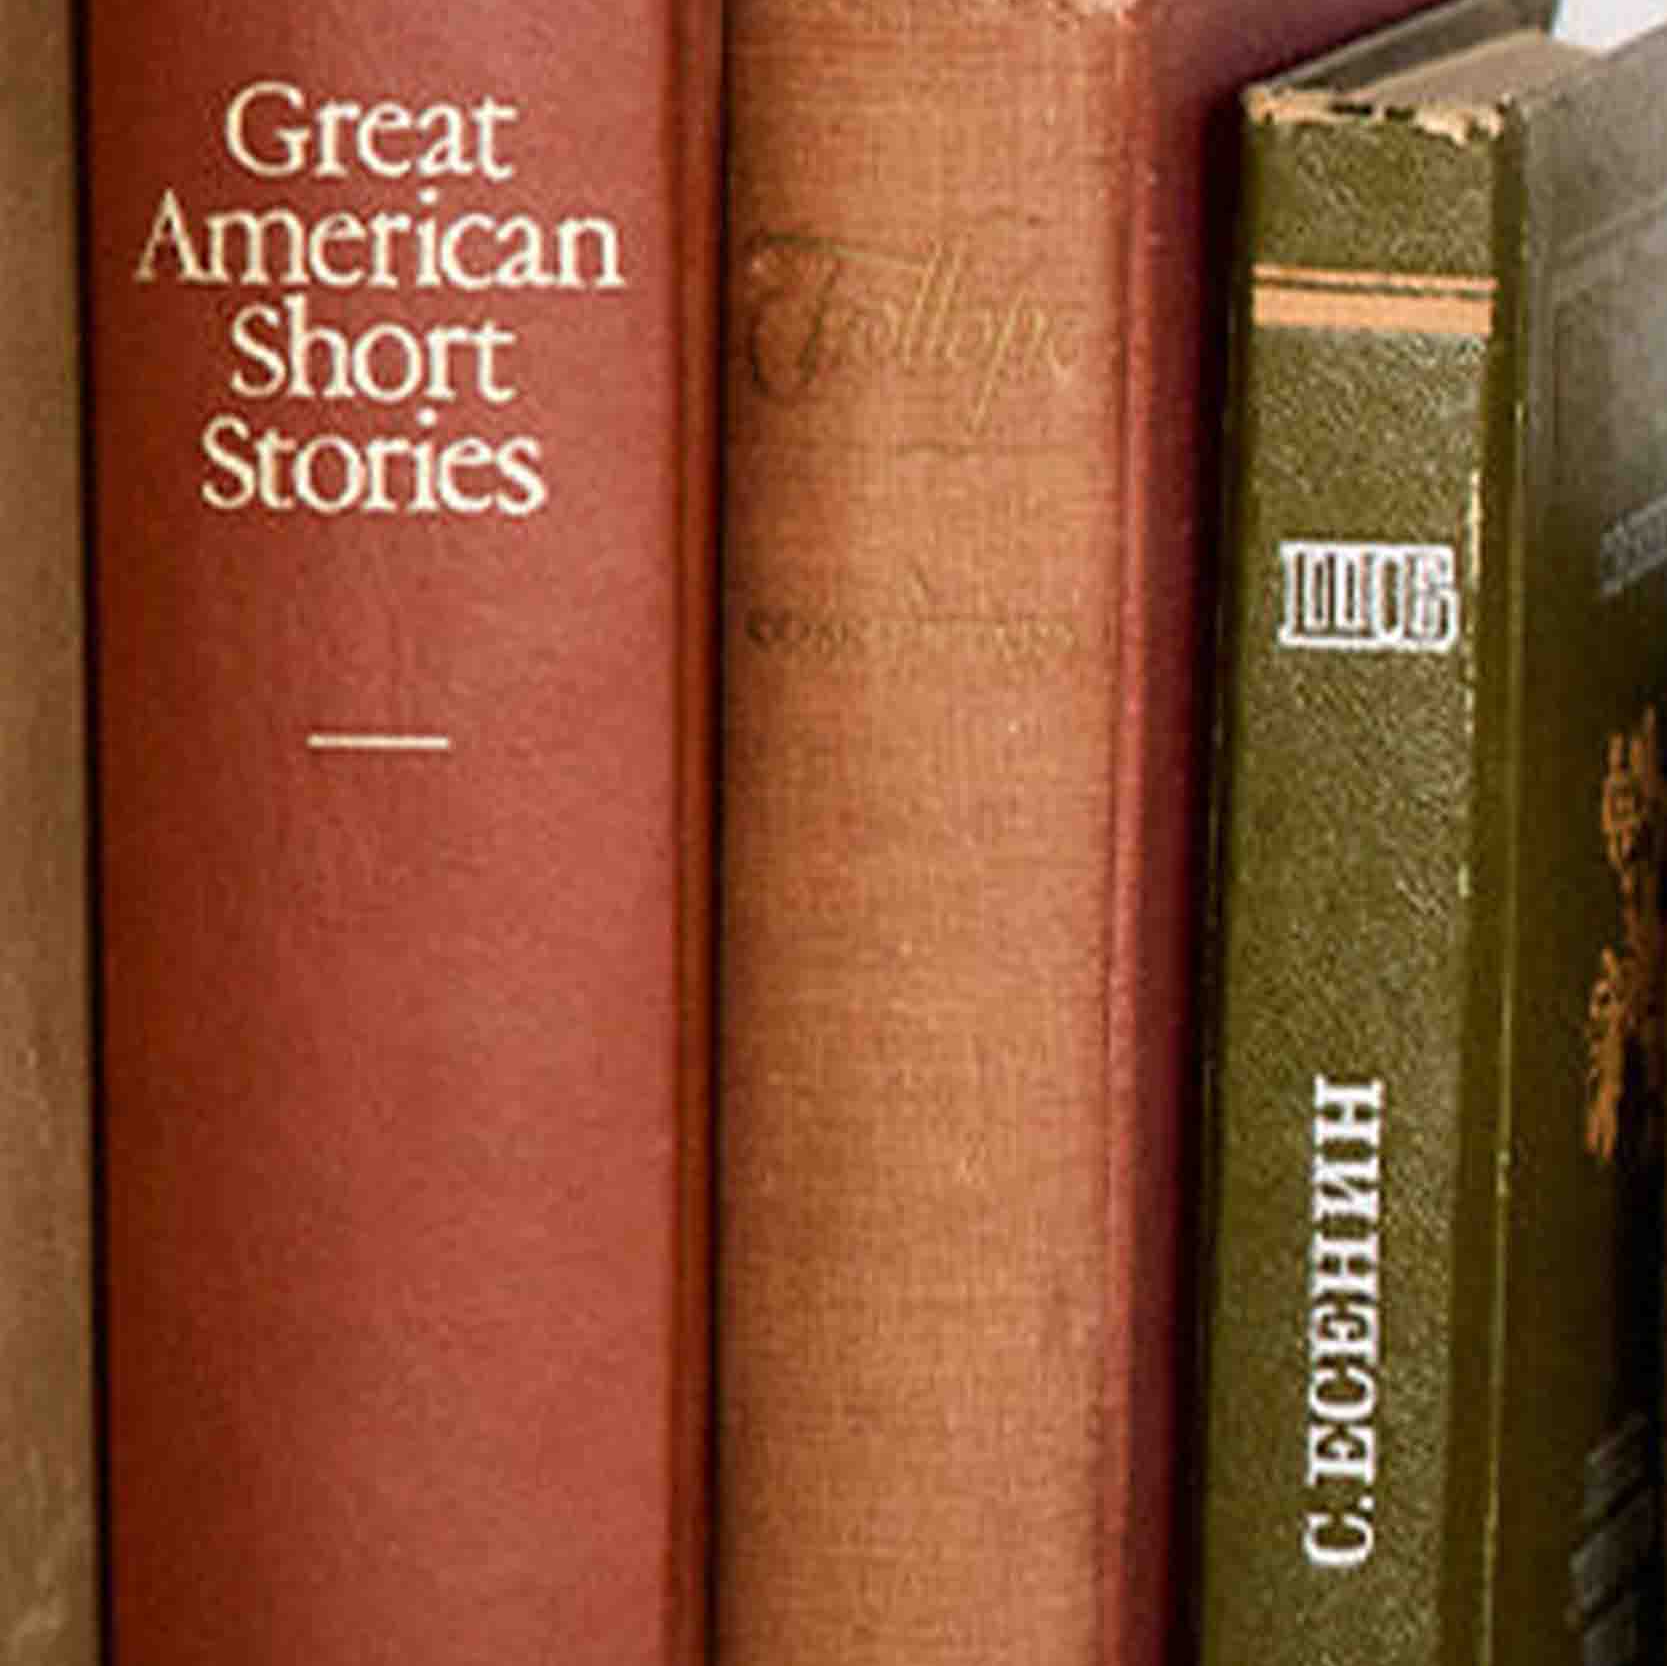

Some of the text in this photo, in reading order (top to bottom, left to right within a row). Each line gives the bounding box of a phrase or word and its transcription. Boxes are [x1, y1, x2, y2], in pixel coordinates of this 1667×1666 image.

[224, 81, 519, 182] Great
[134, 188, 625, 290] American
[230, 293, 518, 405] Short
[201, 408, 548, 517] Stories
